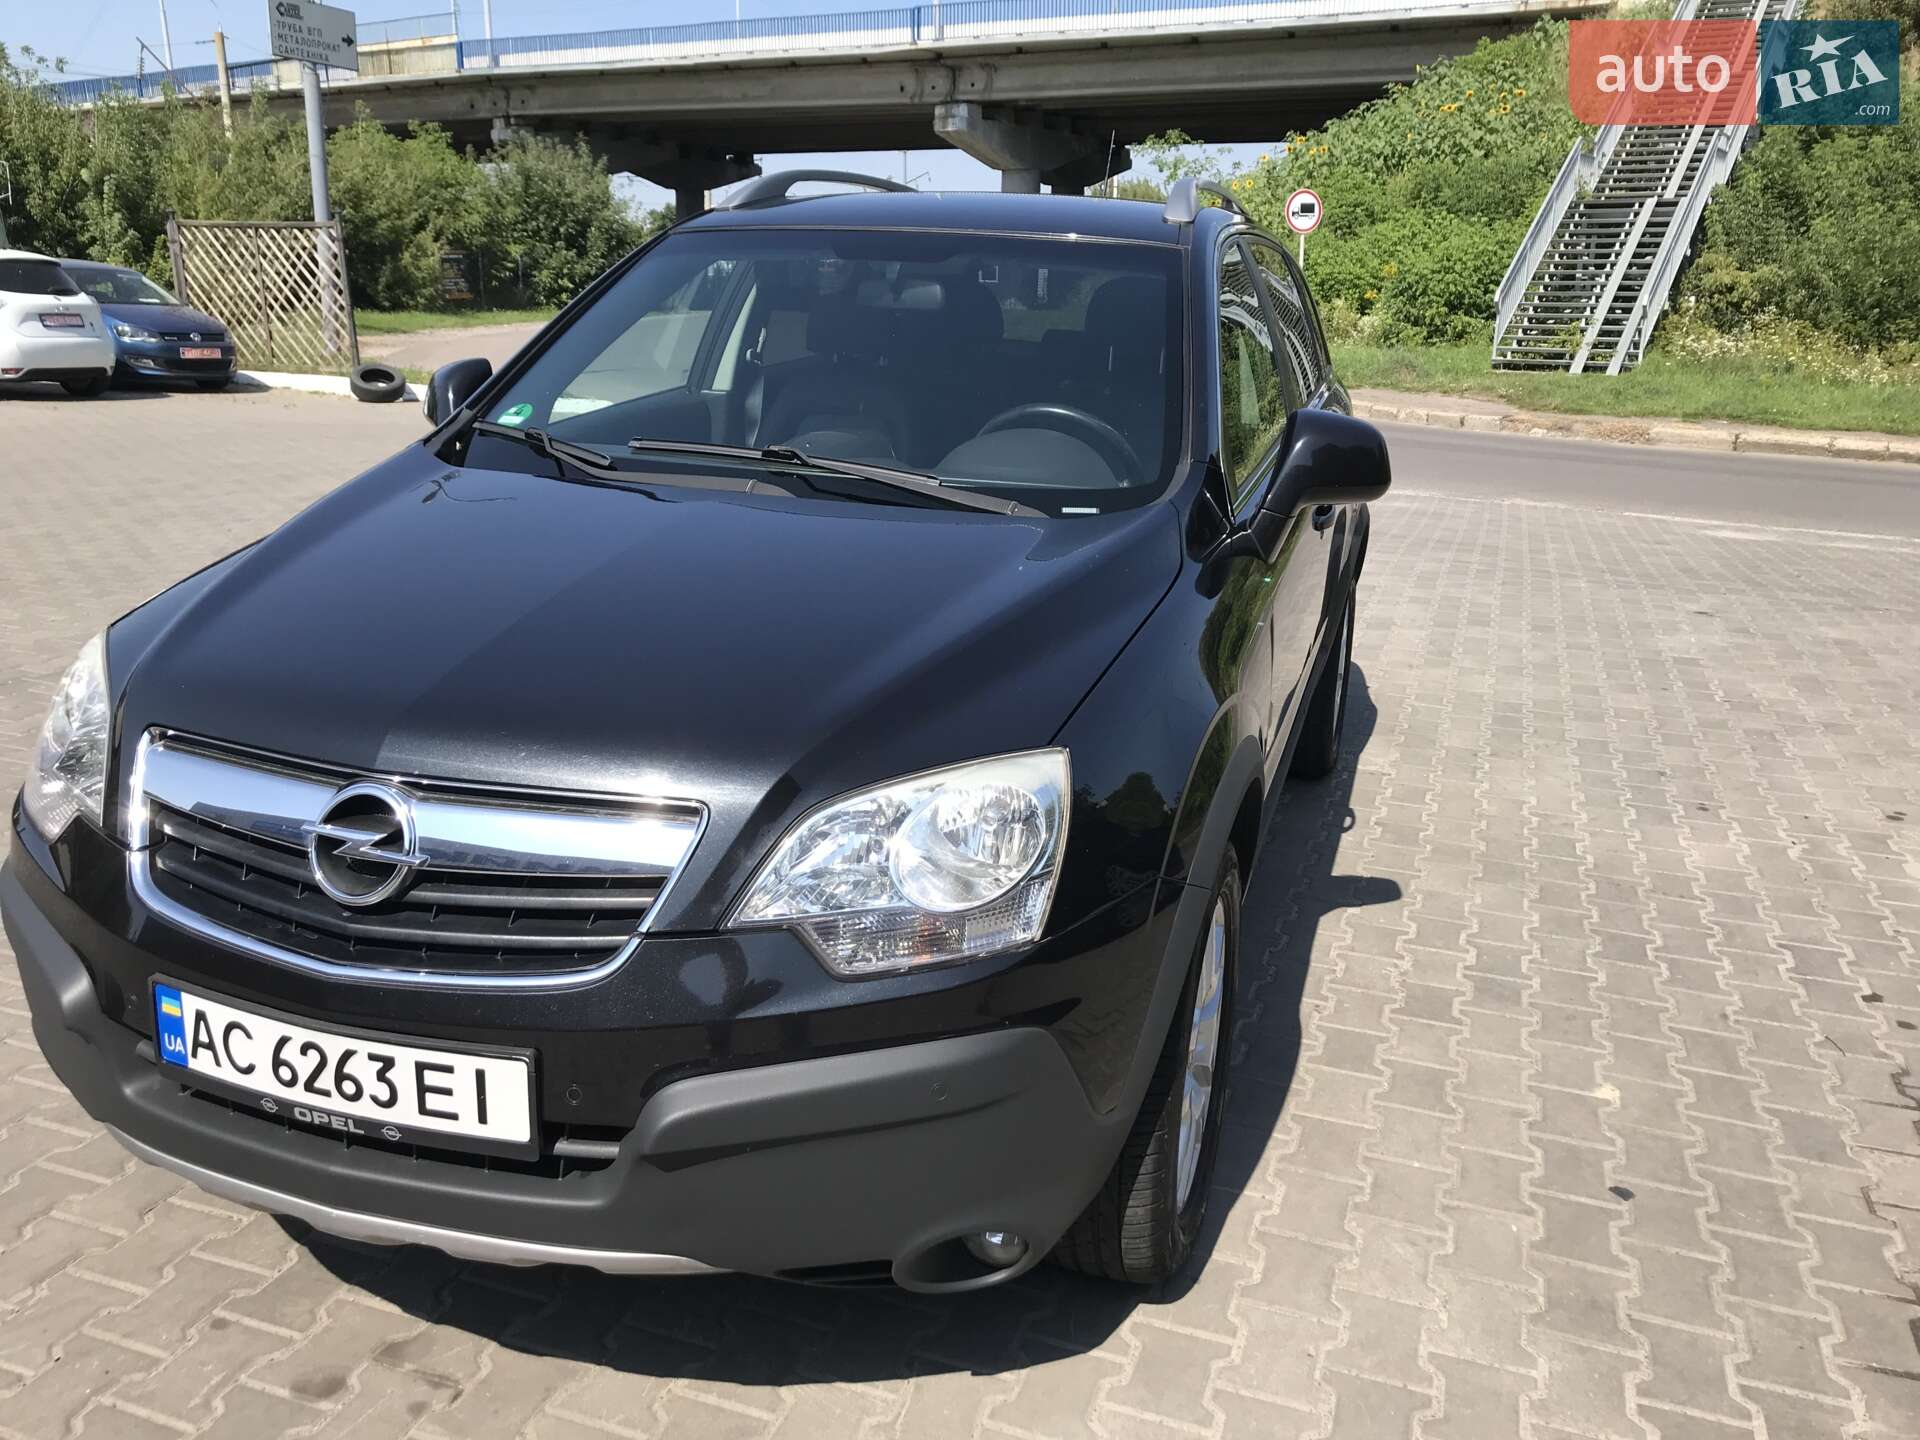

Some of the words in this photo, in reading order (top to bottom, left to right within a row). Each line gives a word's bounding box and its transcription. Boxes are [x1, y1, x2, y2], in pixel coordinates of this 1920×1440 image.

[164, 1033, 185, 1053] UA
[191, 1008, 256, 1076] AC
[271, 1034, 398, 1109] 6263
[414, 1060, 488, 1125] EI
[293, 1105, 365, 1135] OPEL
